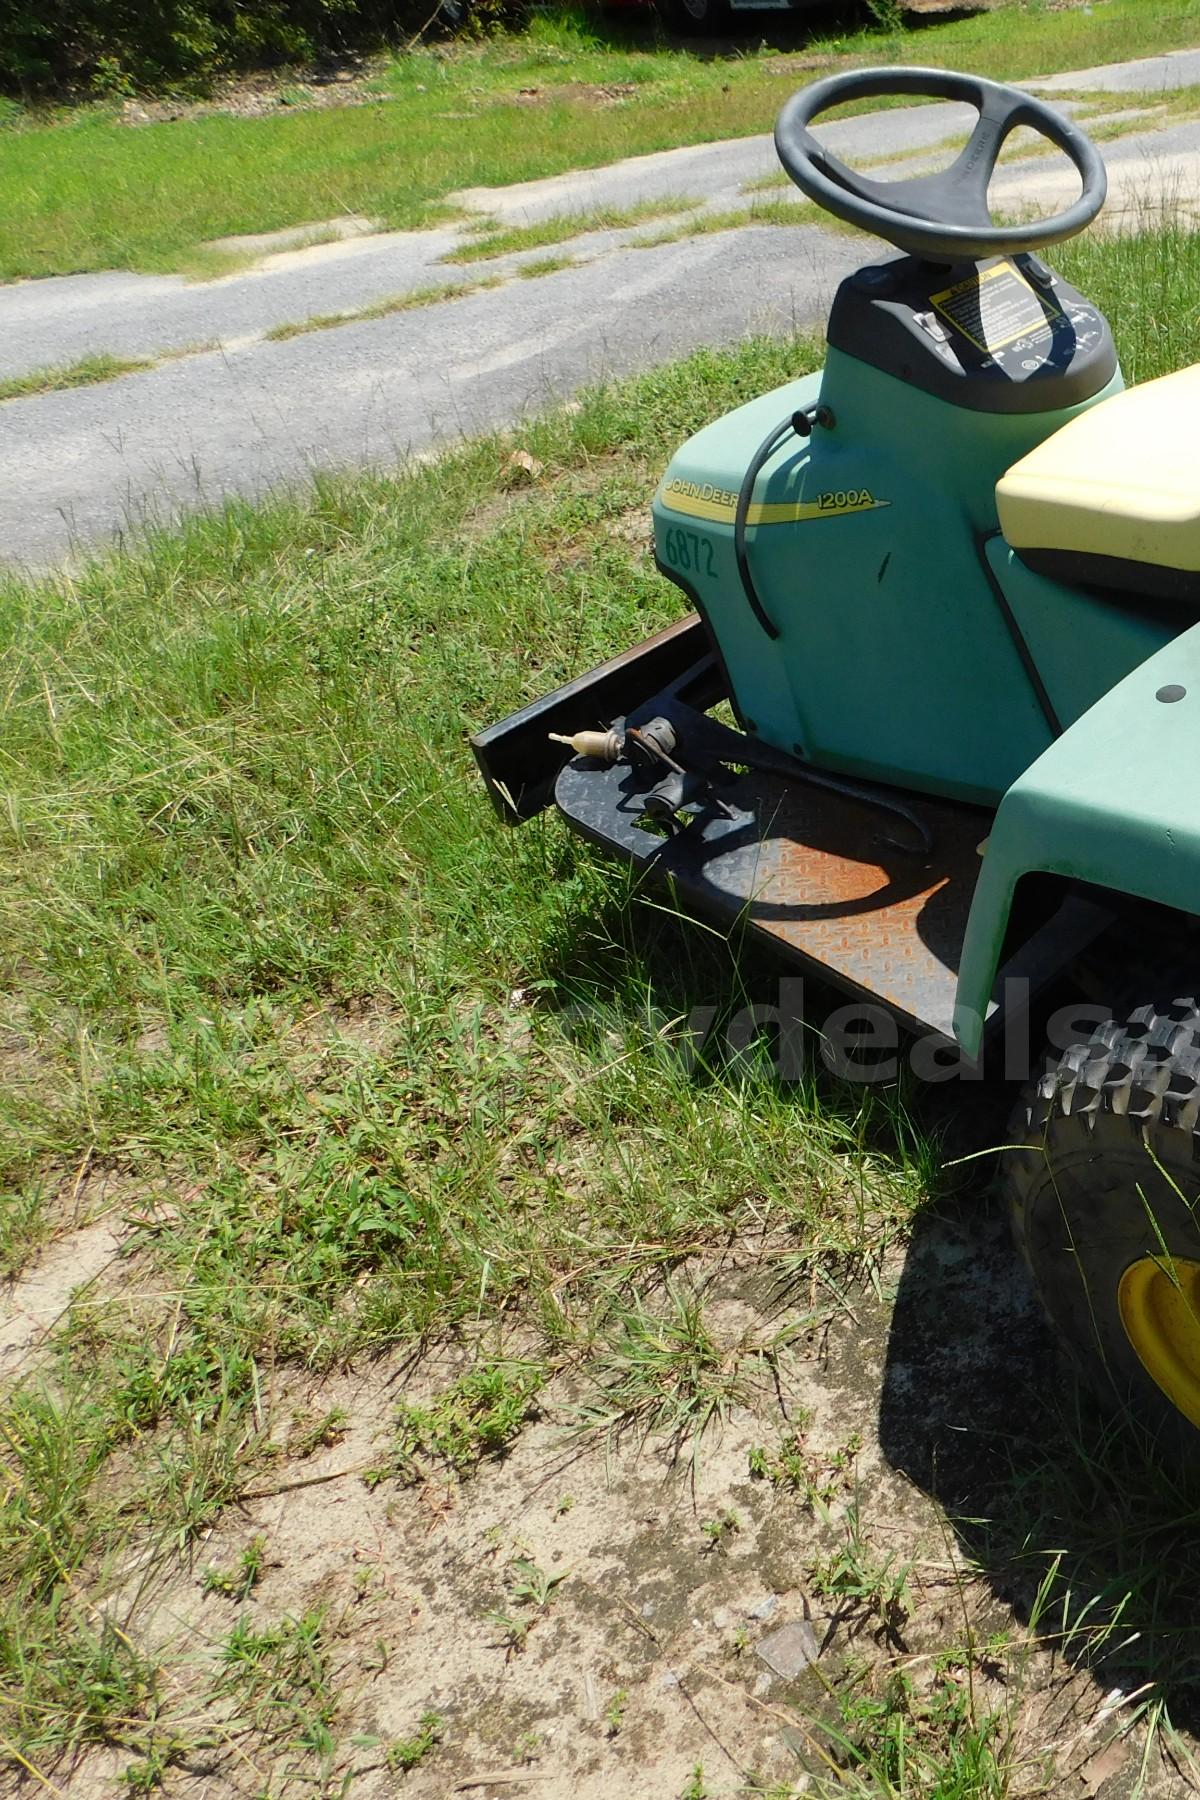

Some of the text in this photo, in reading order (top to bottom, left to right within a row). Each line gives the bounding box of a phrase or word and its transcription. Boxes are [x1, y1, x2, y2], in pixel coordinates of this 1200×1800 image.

[663, 478, 739, 507] JOHN DEER
[817, 488, 874, 510] 1200A
[665, 527, 718, 578] 6872
